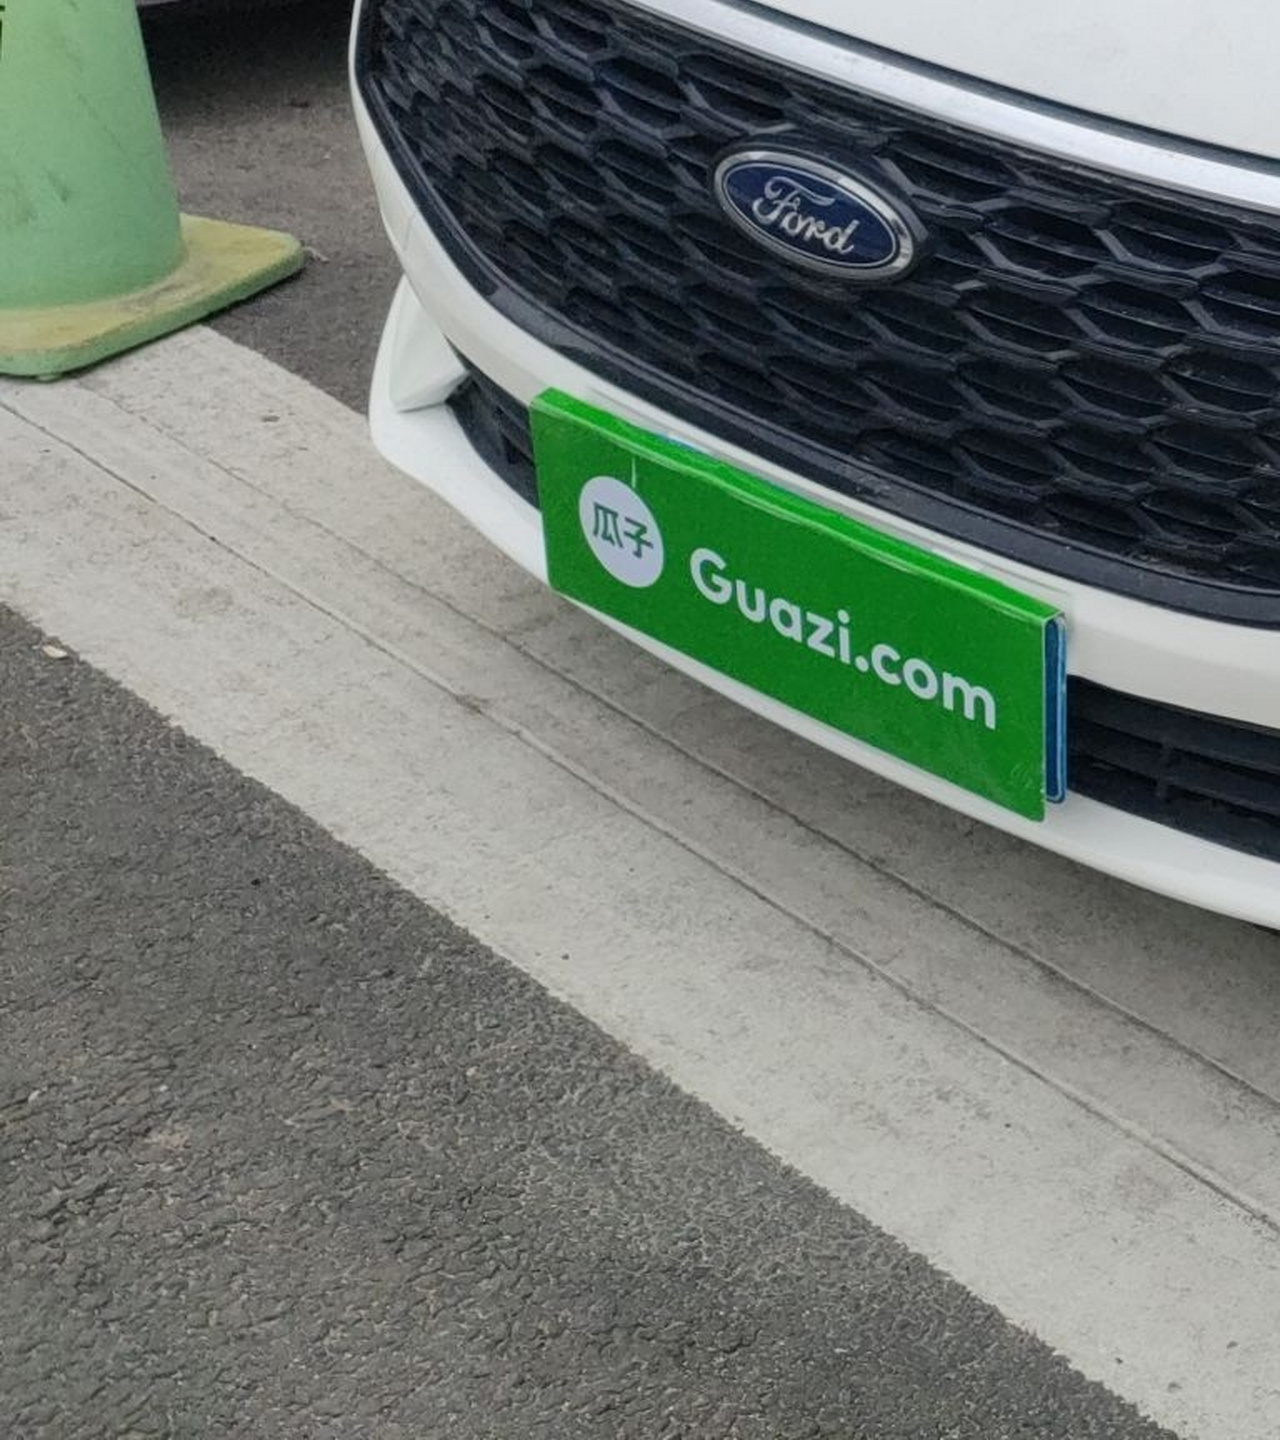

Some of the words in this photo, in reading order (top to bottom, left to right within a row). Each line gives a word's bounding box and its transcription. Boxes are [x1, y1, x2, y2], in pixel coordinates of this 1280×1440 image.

[752, 176, 860, 255] Ford
[592, 503, 654, 559] 瓜子
[690, 548, 996, 730] Guazi.com
